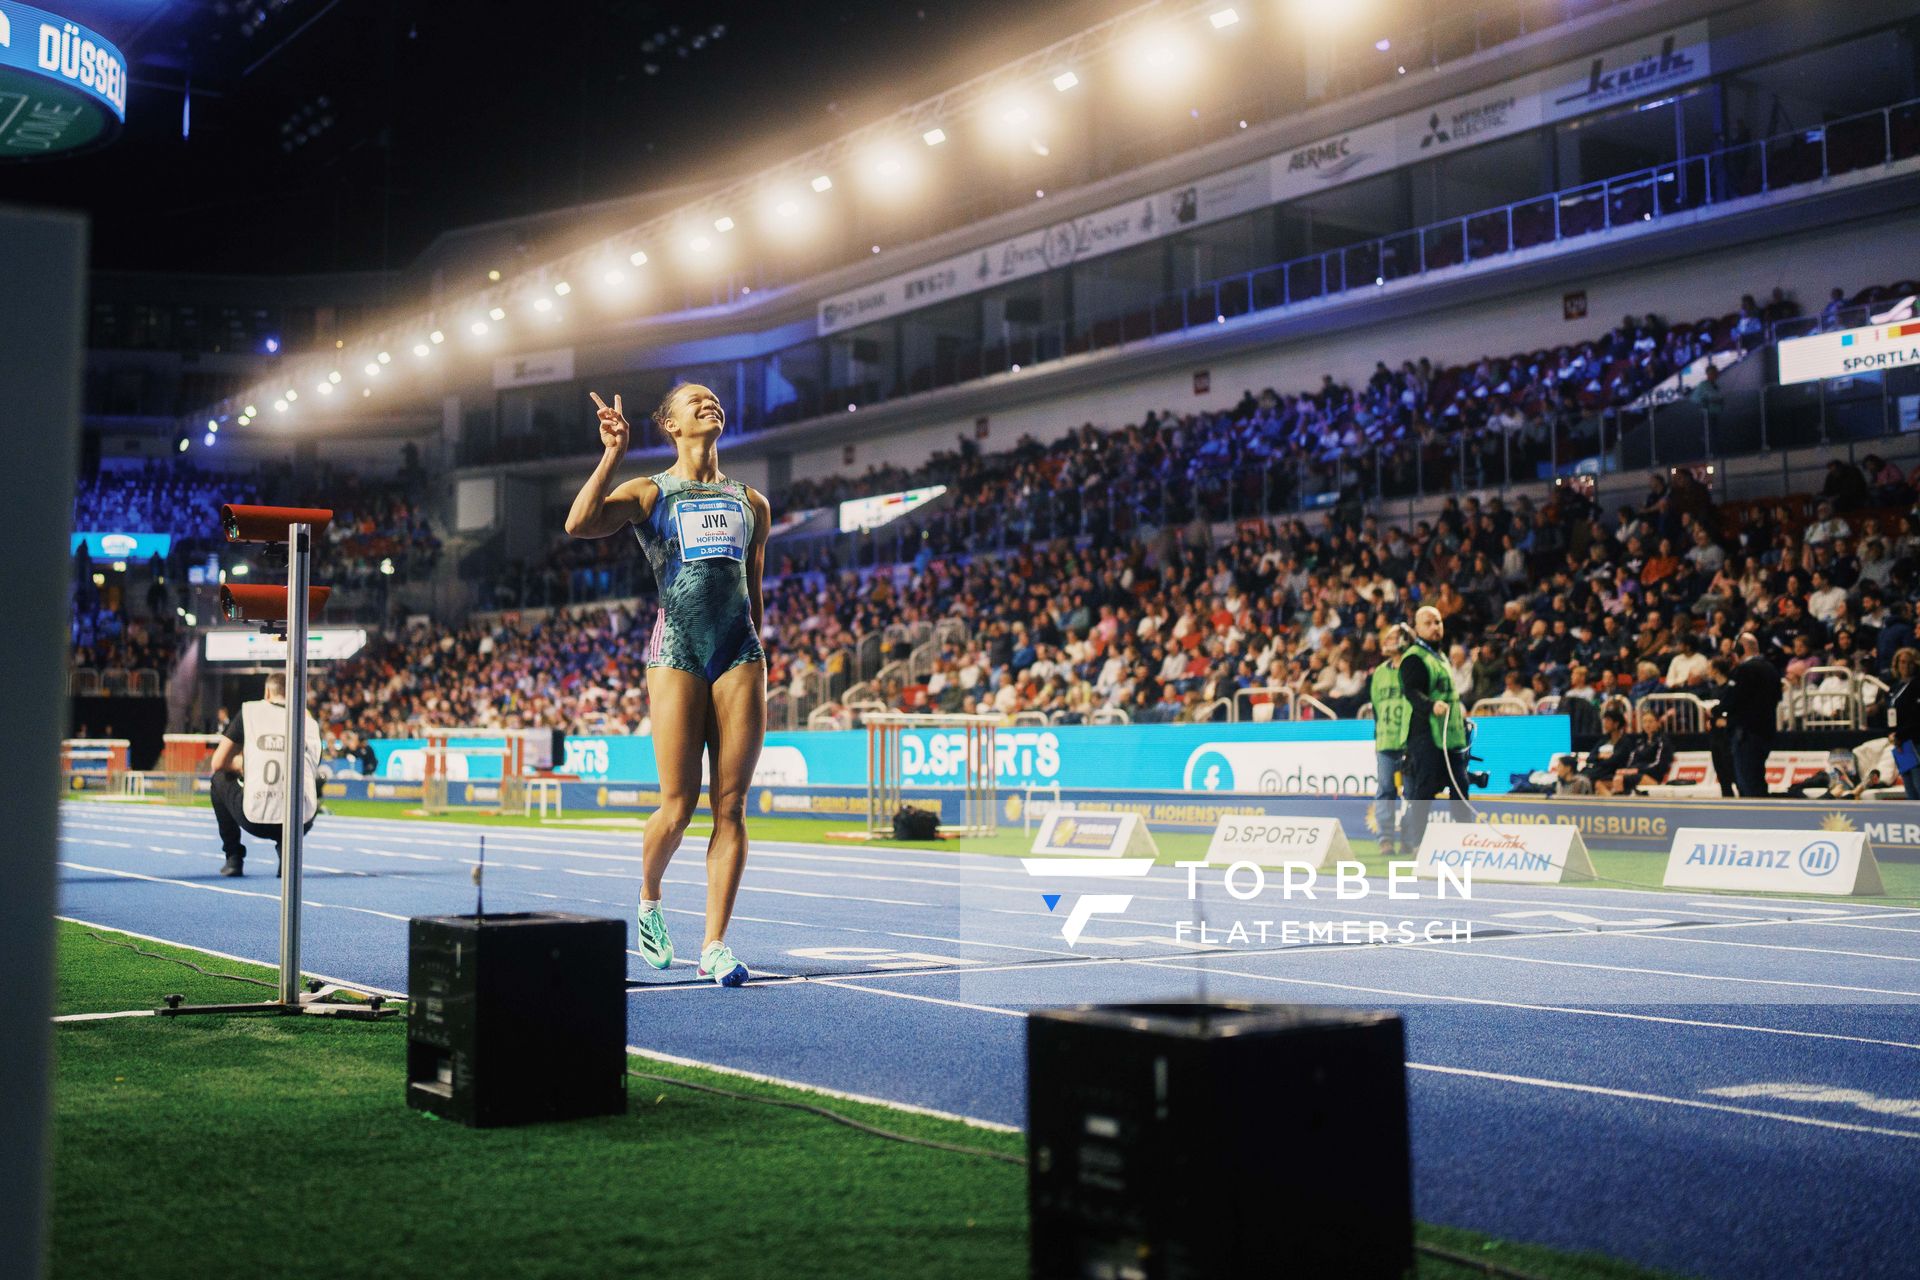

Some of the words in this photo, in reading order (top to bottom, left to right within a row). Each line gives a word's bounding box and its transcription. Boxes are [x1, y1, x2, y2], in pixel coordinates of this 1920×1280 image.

[38, 23, 126, 117] DÜSSEL
[1288, 137, 1349, 173] AERMEC
[701, 513, 728, 528] JIYA
[696, 535, 736, 544] HOFFMANN
[902, 731, 1060, 778] D.SPORTS
[1259, 764, 1378, 793] @dspor
[1223, 825, 1320, 845] D.SPORTS
[1475, 812, 1549, 826] CASINO
[1556, 814, 1668, 836] DUISBURG
[1864, 822, 1920, 844] MER
[1430, 848, 1553, 872] HOFFMANN
[1686, 843, 1791, 869] Allianz
